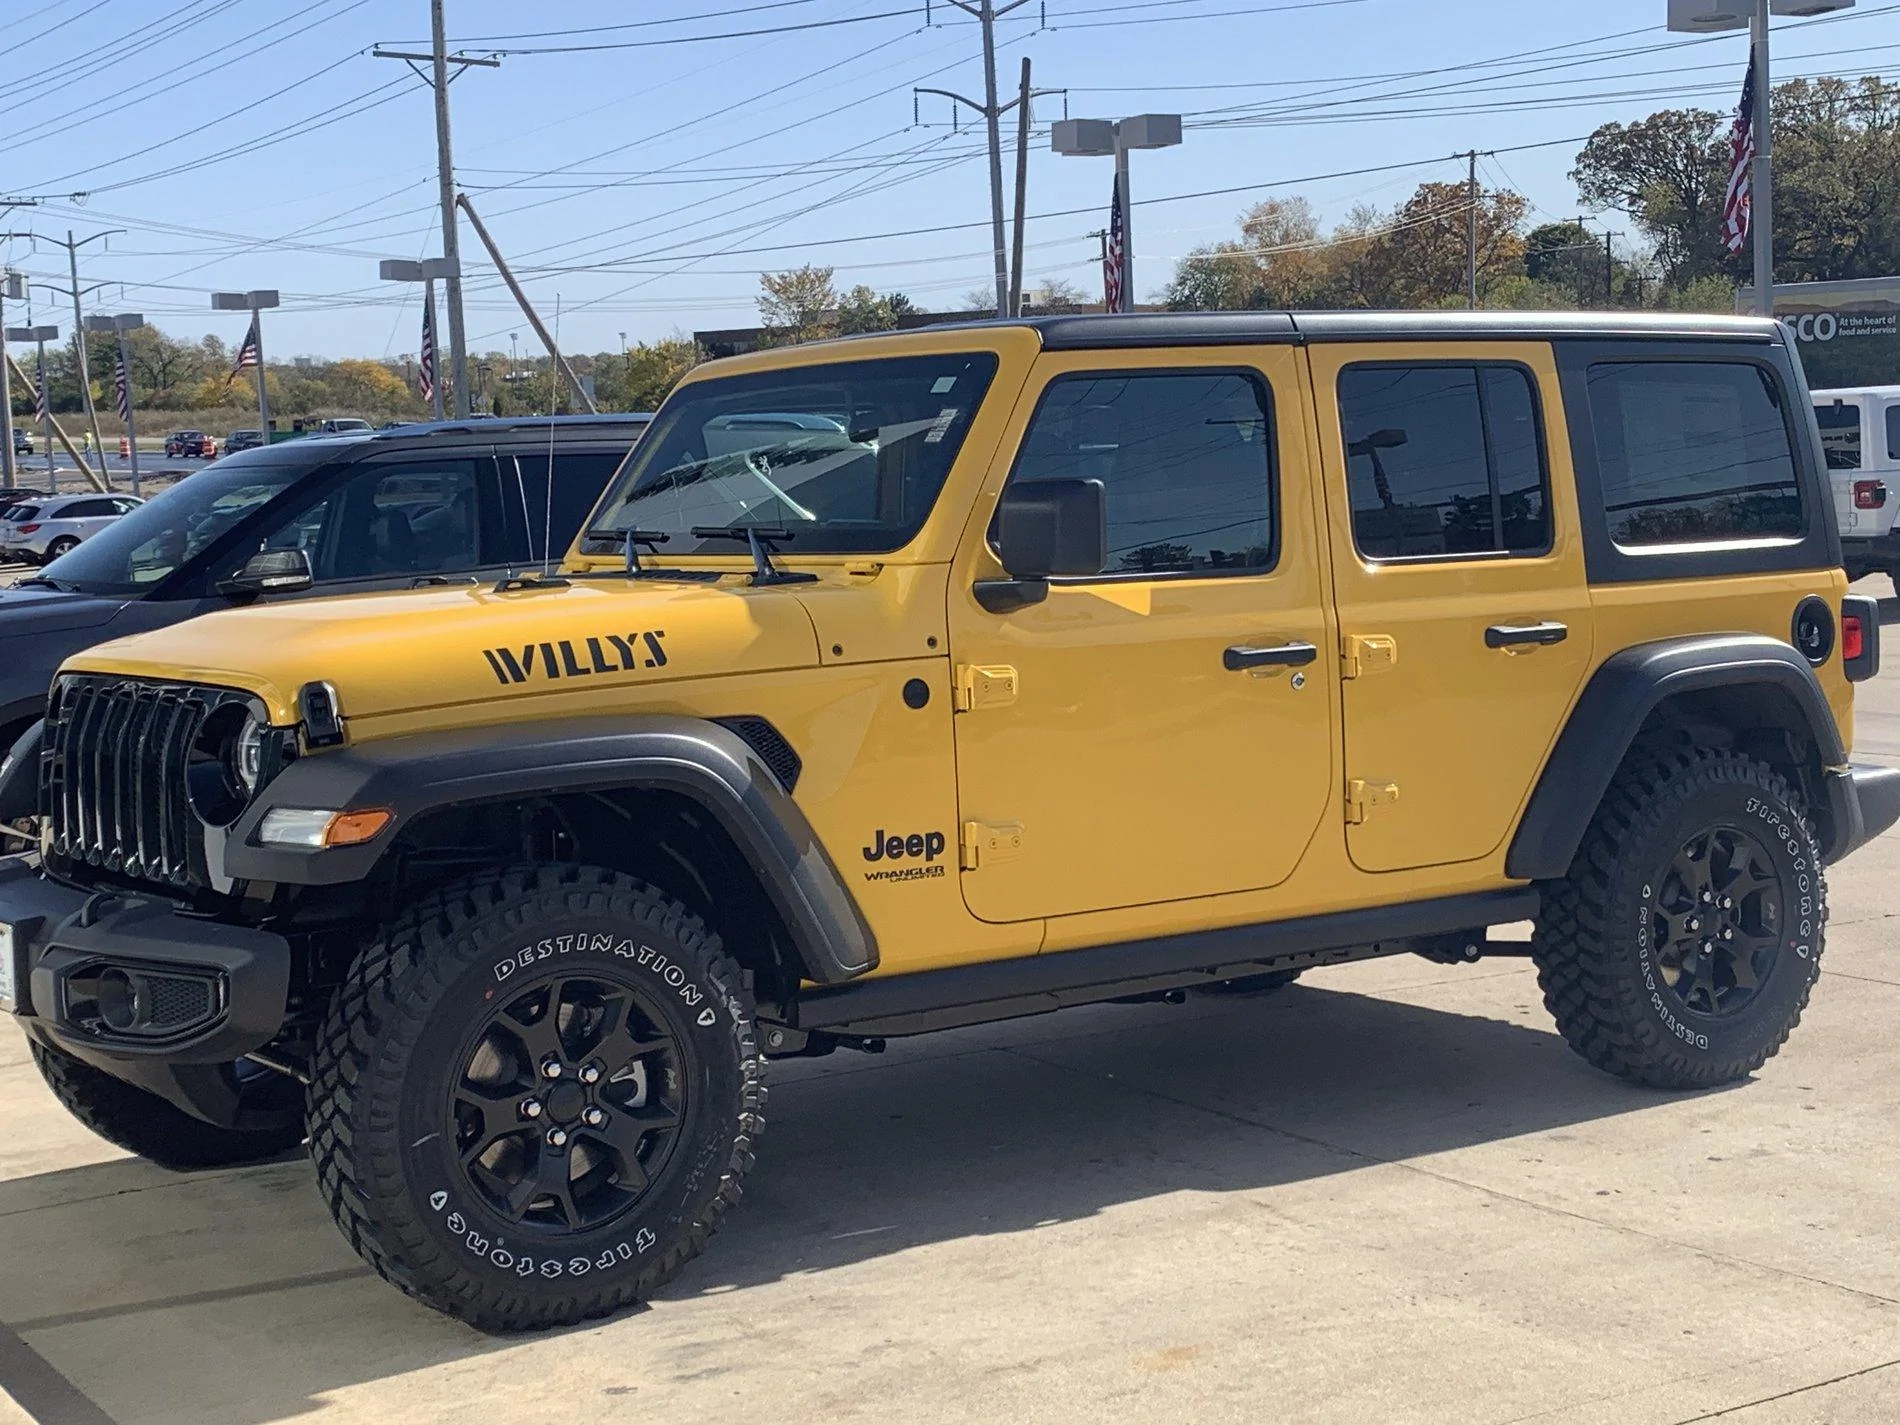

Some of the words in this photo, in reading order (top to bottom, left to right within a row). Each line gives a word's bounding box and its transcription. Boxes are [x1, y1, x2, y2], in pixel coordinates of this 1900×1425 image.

[1838, 327, 1856, 336] food
[1856, 326, 1871, 335] and
[1871, 326, 1897, 335] service
[1839, 317, 1848, 327] At
[1849, 316, 1863, 326] the
[1863, 315, 1886, 326] heart
[1886, 314, 1897, 325] of
[482, 630, 668, 684] WILLYS
[862, 829, 946, 862] Jeep
[864, 865, 945, 881] WRANGLER
[493, 932, 704, 1006] DESTINATION
[1637, 906, 1709, 1051] DESTINATION
